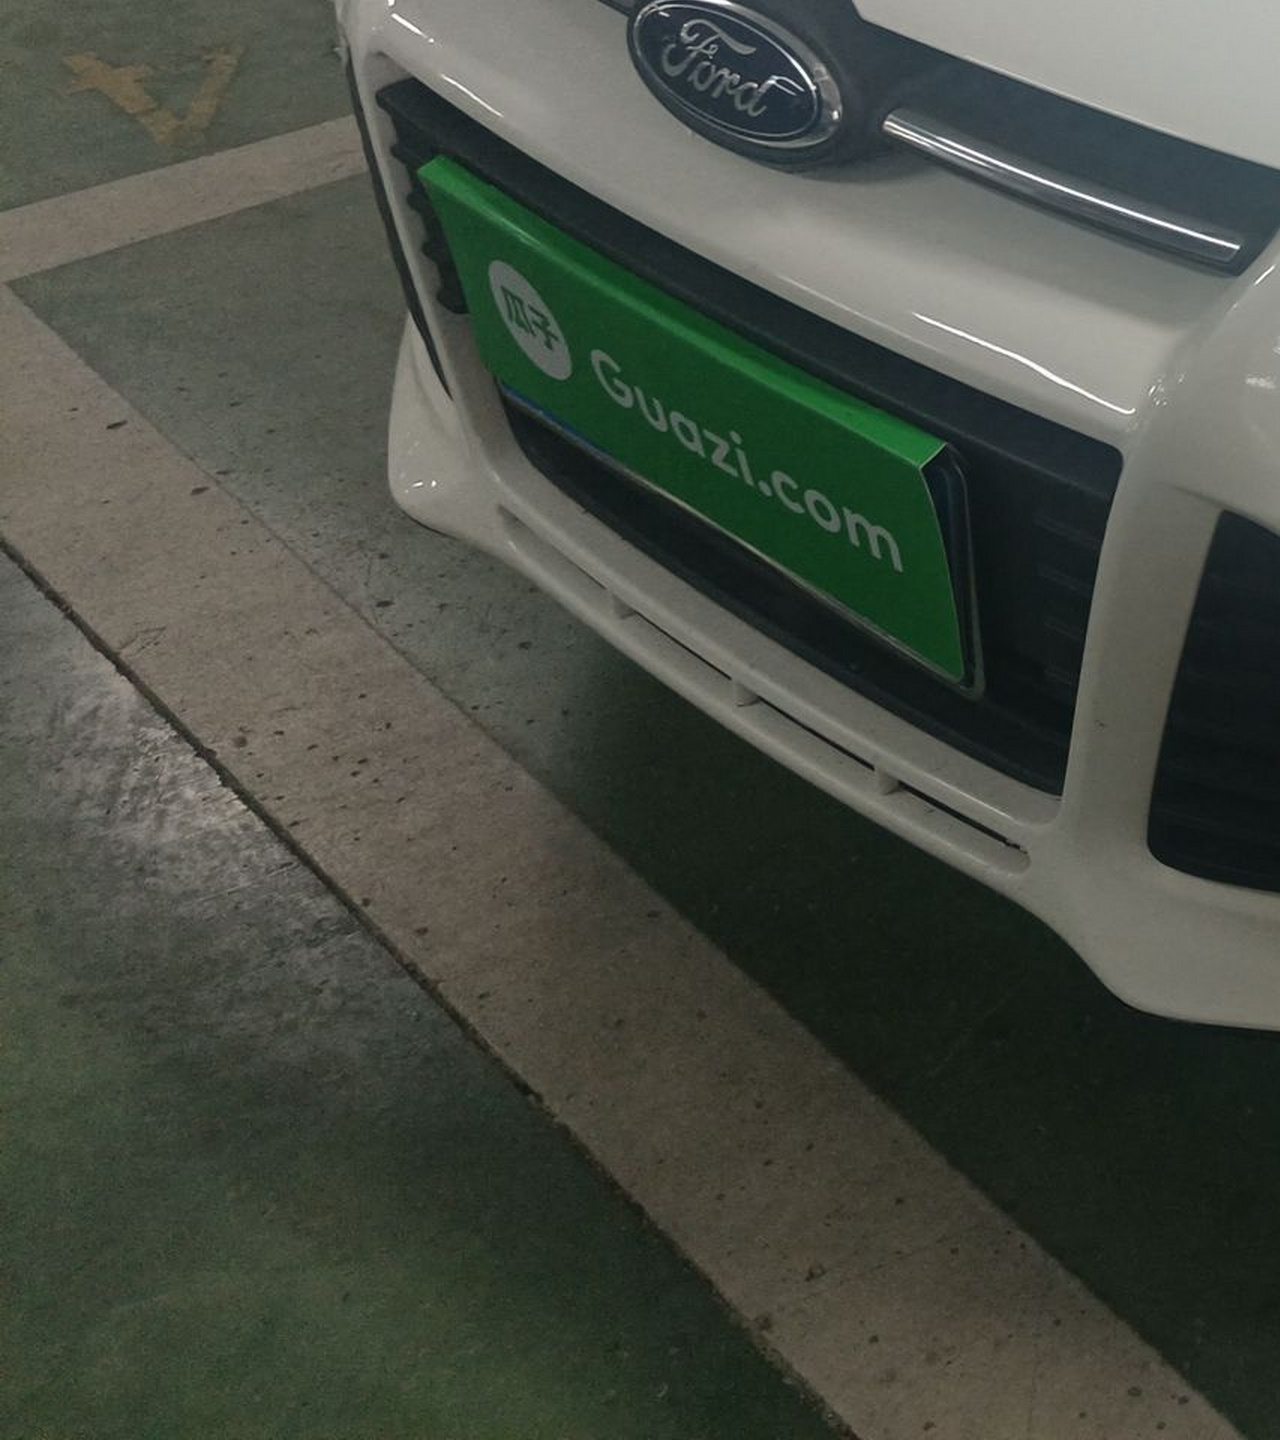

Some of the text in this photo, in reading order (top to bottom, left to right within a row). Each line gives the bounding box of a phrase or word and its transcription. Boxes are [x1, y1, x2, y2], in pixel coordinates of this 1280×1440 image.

[662, 18, 804, 117] Ford
[500, 284, 903, 573] 瓜子 Guazi.com
